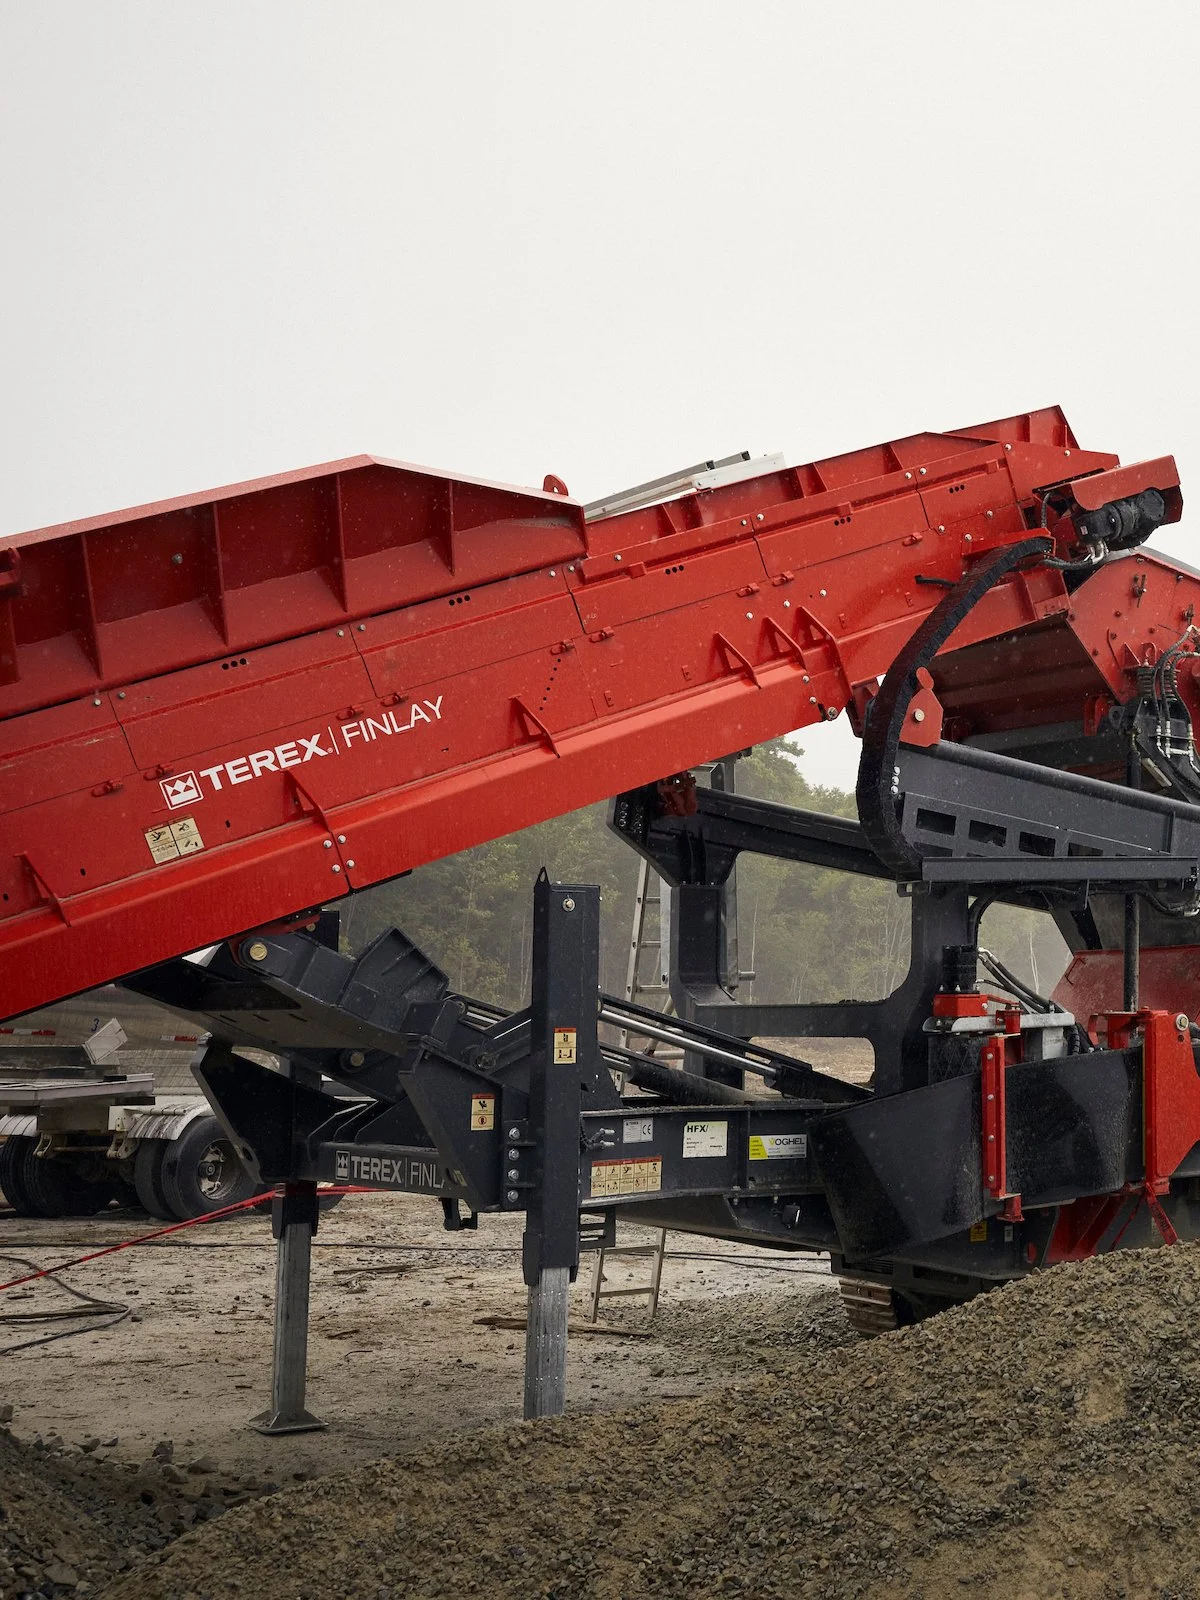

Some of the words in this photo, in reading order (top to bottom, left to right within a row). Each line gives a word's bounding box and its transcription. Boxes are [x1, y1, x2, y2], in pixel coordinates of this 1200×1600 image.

[200, 733, 329, 791] TEREX
[341, 695, 443, 748] FINLAY
[351, 1155, 402, 1184] TEREX
[410, 1161, 444, 1189] FINL
